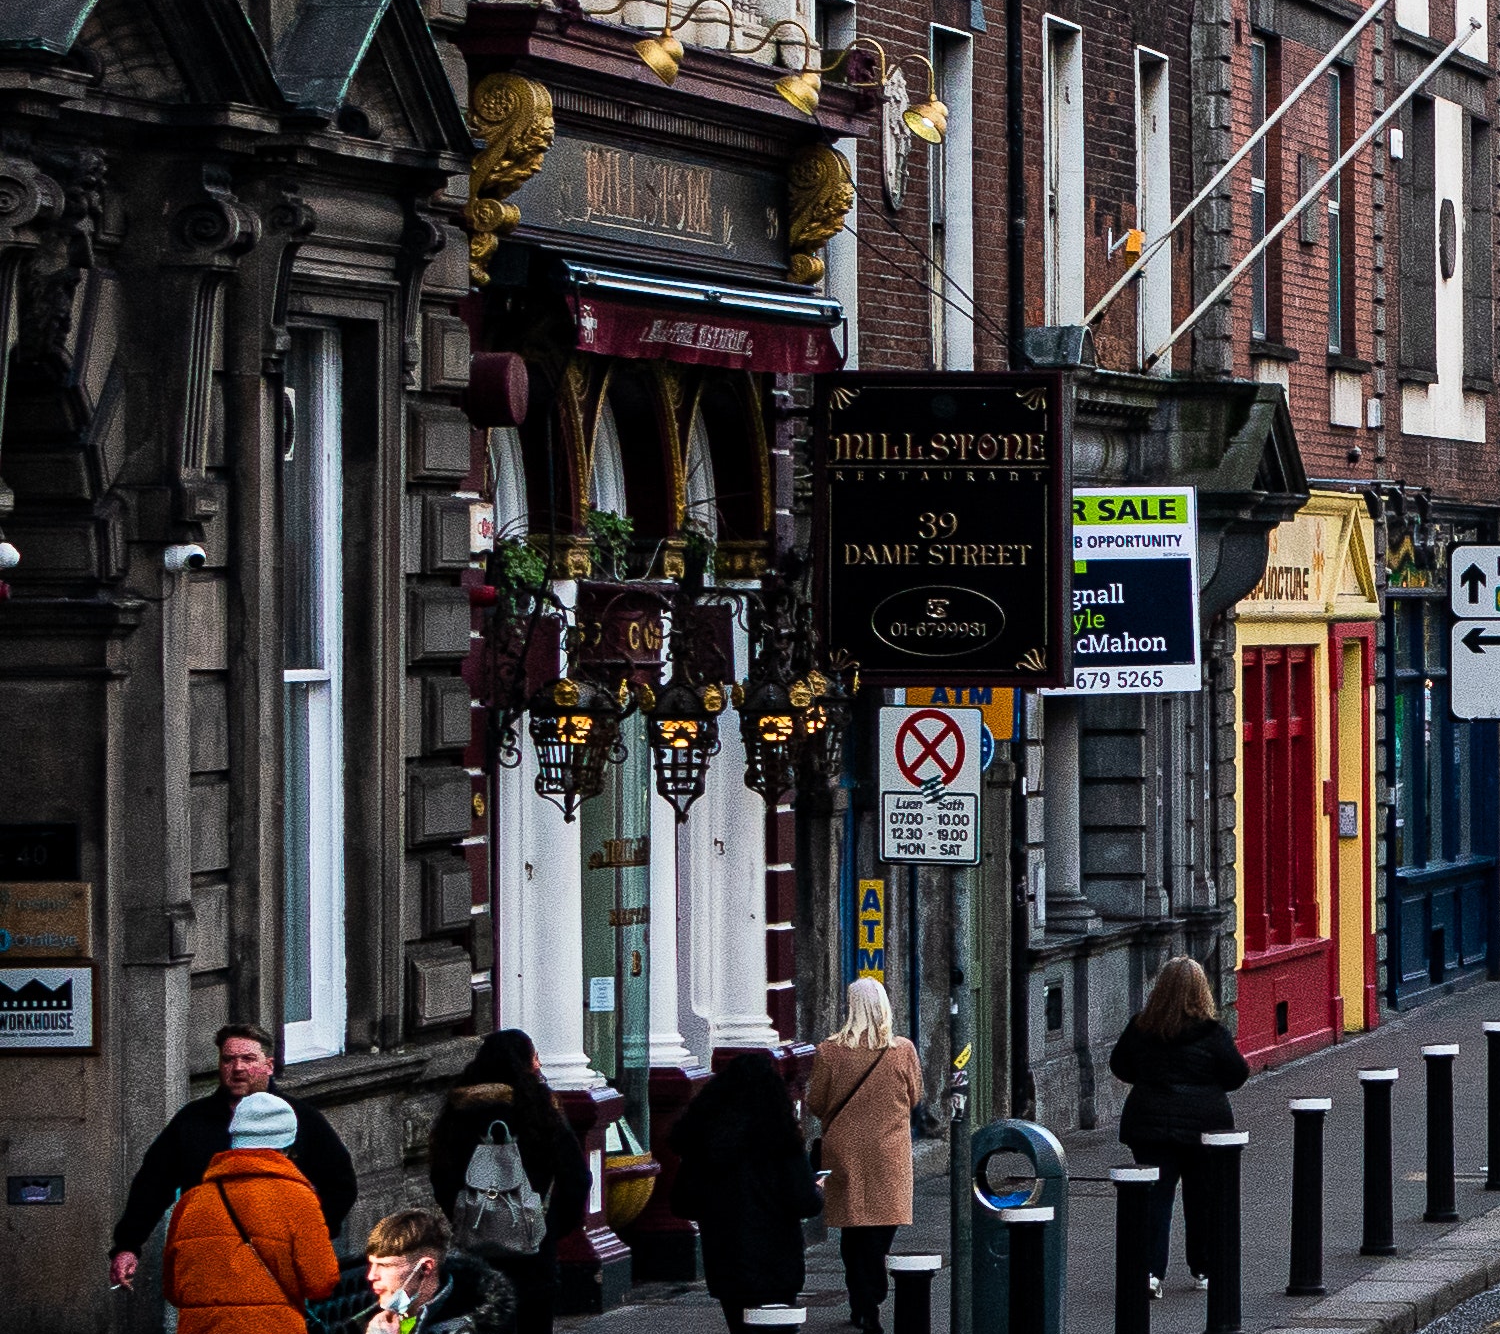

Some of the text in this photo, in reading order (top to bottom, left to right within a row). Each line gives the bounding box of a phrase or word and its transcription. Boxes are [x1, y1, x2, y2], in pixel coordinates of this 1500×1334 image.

[829, 433, 1046, 461] MILLSTONE
[835, 471, 1043, 481] RESTAURANT
[1098, 499, 1177, 521] SALE
[918, 512, 959, 539] 39
[1086, 534, 1183, 549] OPPORTUNITY
[844, 544, 1033, 566] DAME STREET
[1073, 583, 1125, 610] gnall
[1073, 609, 1106, 635] yle
[1073, 632, 1168, 654] cMahon
[1075, 670, 1164, 689] 679 5265
[930, 687, 994, 705] ATM
[889, 812, 970, 827] 07.00 10.00
[891, 828, 923, 841] 12.30
[896, 842, 962, 856] MON SAT
[858, 888, 885, 970] ATM
